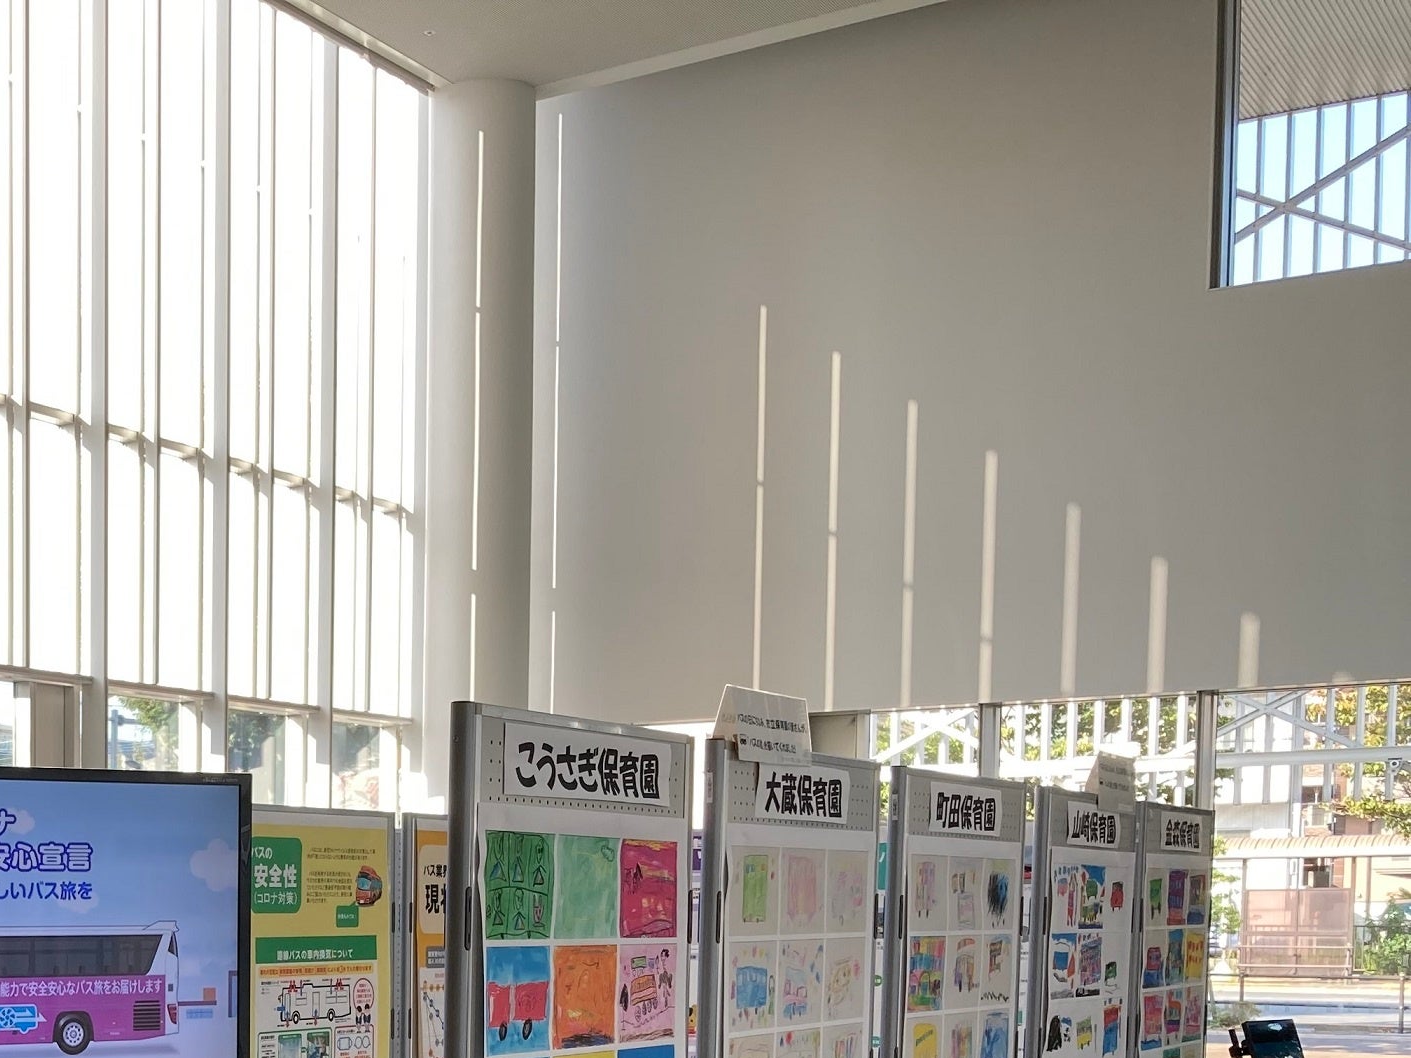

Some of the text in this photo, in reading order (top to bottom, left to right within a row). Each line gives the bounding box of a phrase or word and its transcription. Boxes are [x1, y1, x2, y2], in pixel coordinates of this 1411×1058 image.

[516, 742, 660, 799] こうさぎ保育園
[765, 771, 842, 818] 大蔵保育園
[936, 791, 996, 832] 町田保育園
[1071, 809, 1117, 845] 山崎保育園
[1165, 819, 1200, 849] 金森保育園
[254, 863, 297, 888] 安全性
